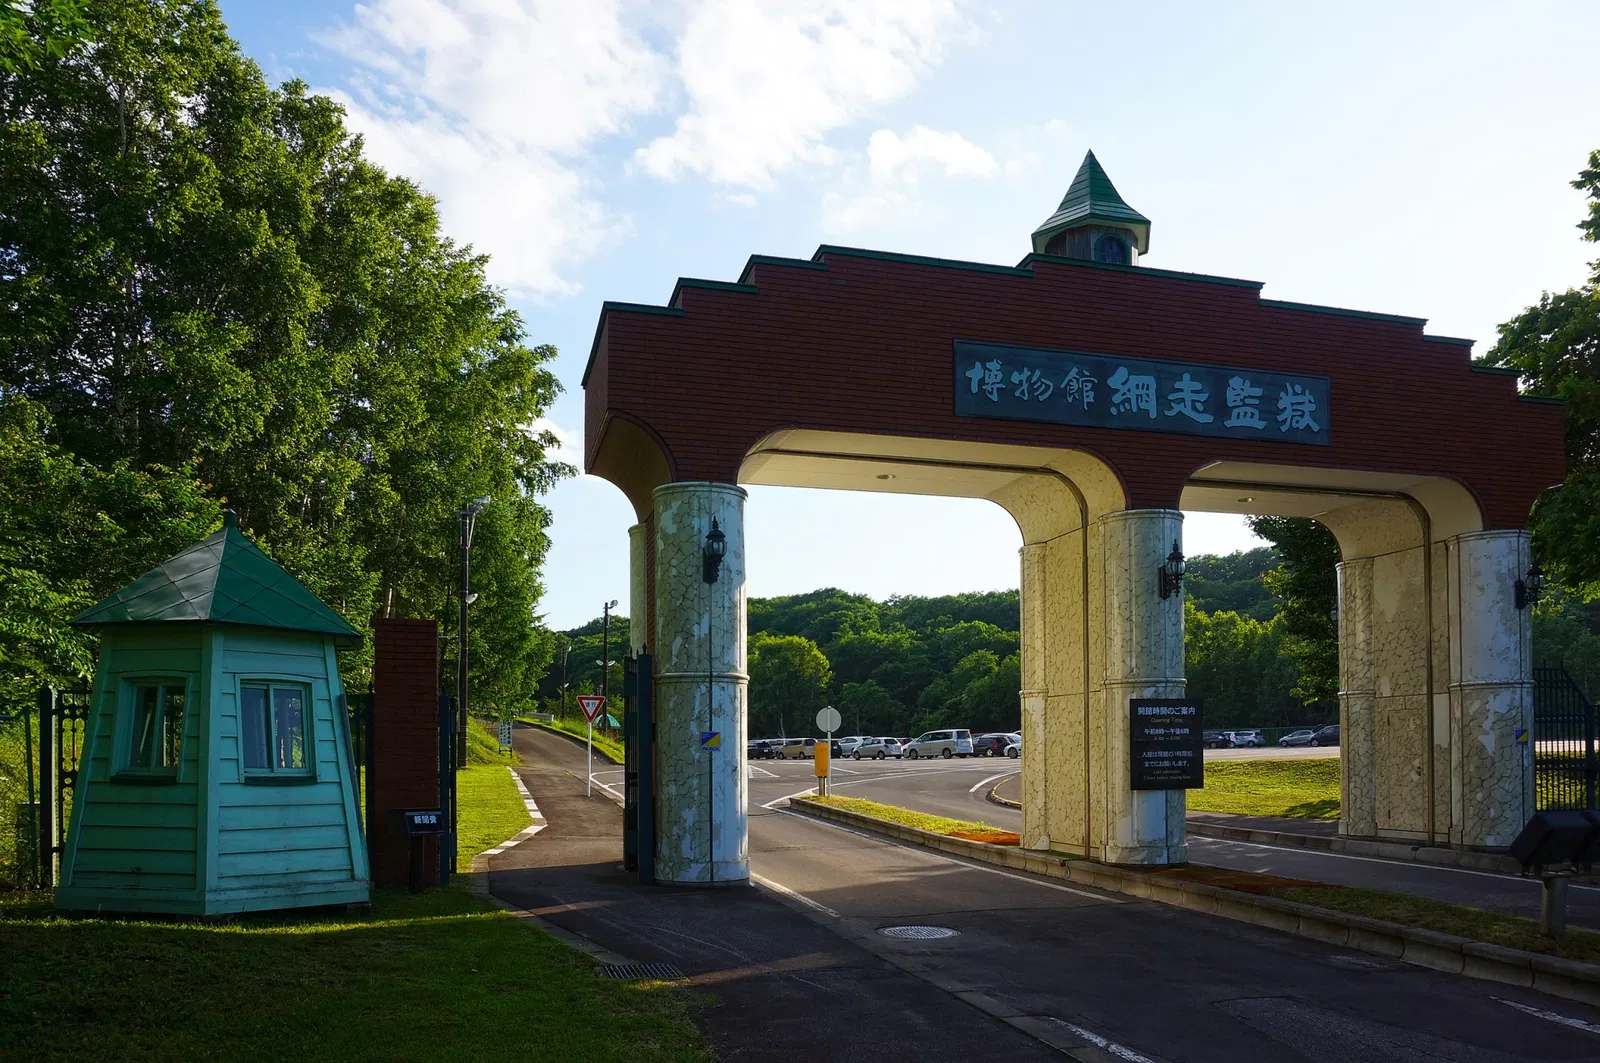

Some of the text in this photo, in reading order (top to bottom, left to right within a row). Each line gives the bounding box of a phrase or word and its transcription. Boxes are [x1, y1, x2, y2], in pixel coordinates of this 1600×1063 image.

[1138, 706, 1196, 715] 開館時間のご案内
